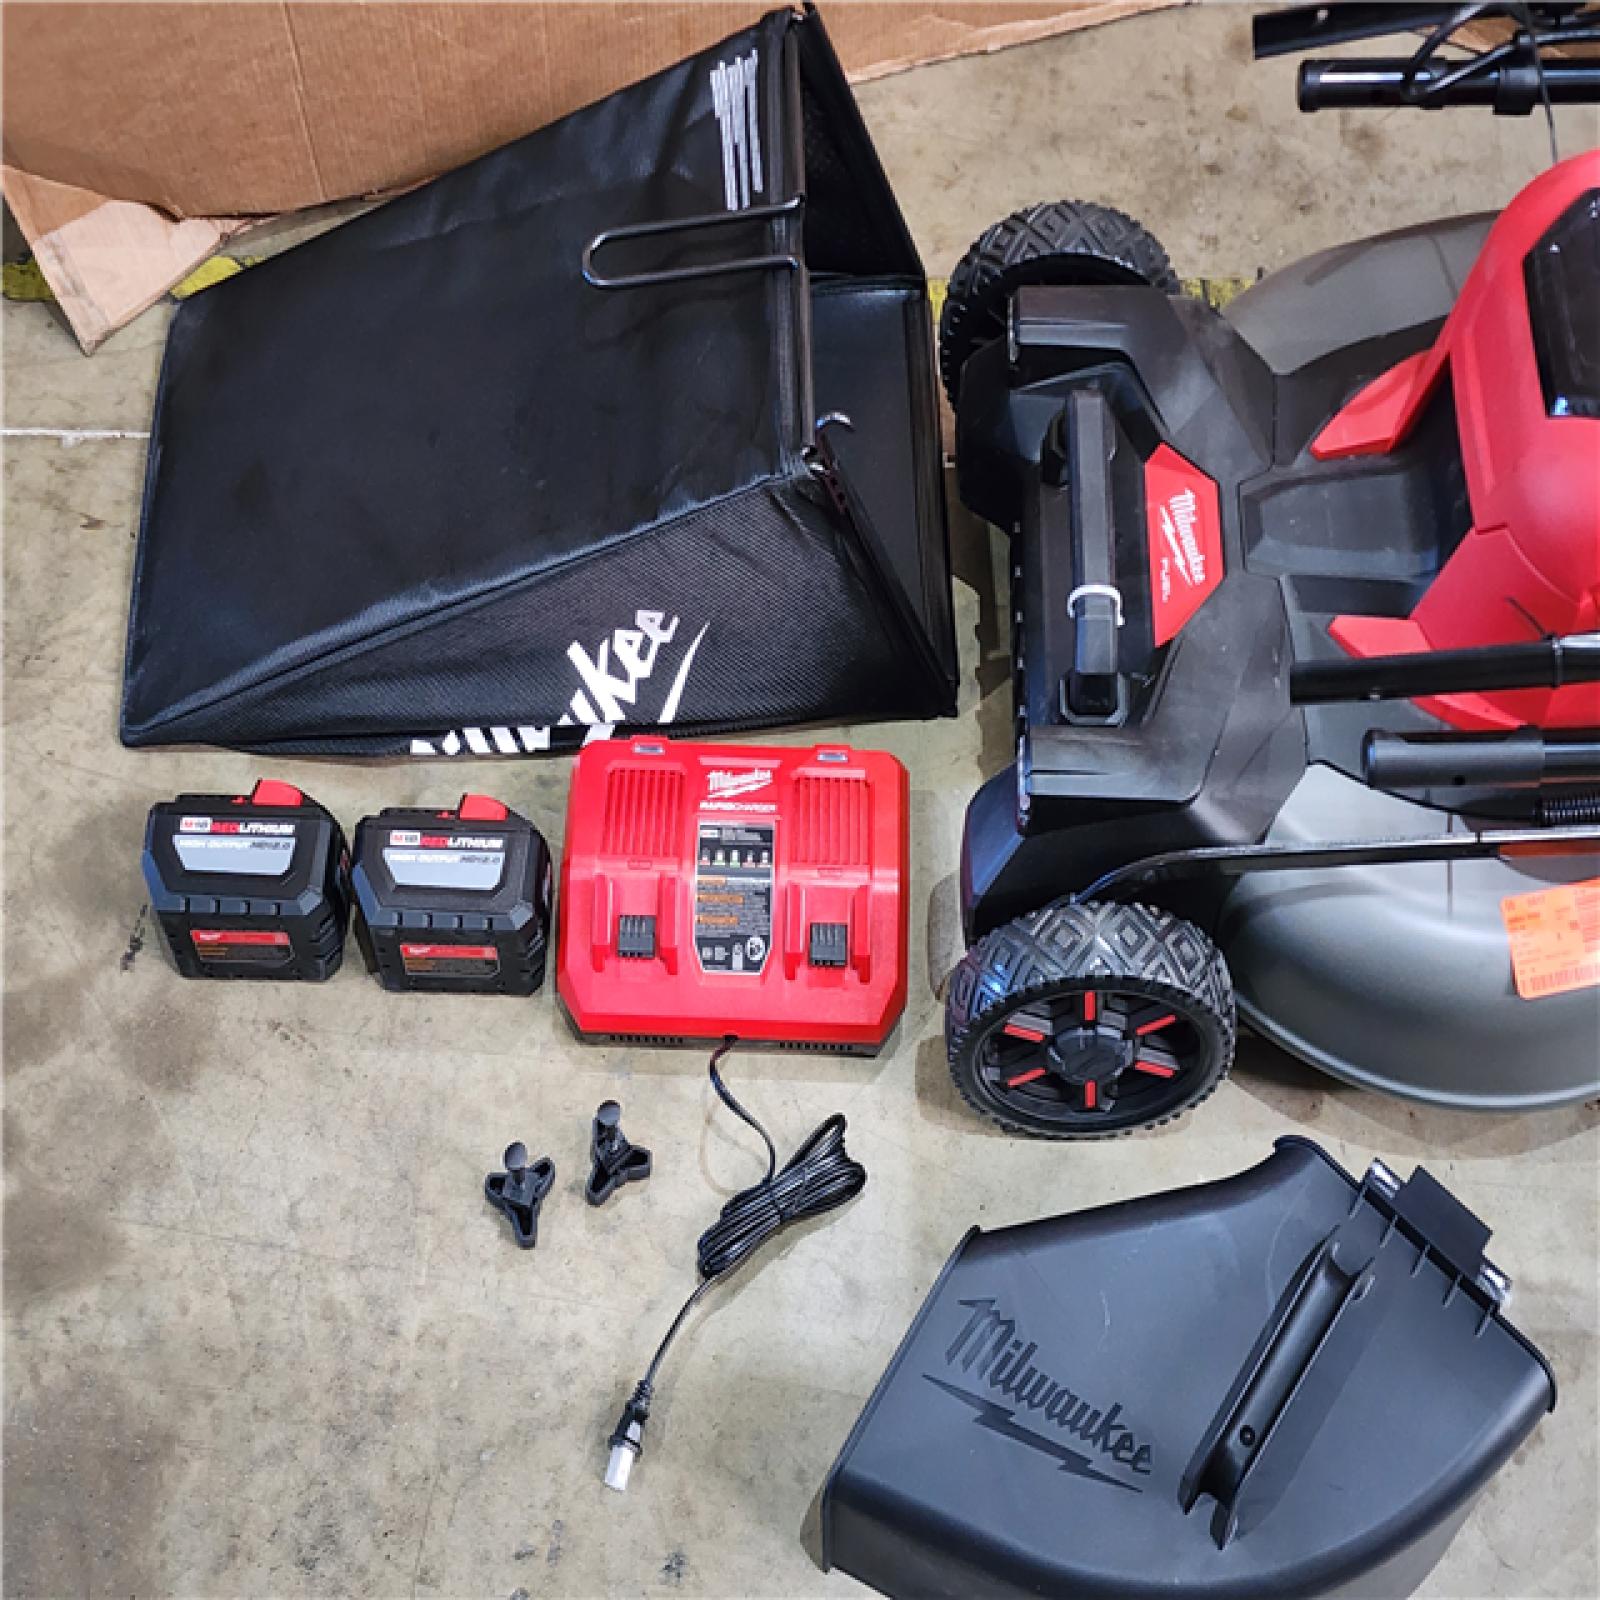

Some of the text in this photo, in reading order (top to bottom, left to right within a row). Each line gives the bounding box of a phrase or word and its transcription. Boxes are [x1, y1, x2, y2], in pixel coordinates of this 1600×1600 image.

[1168, 487, 1206, 586] Milwaukee
[707, 768, 772, 791] Milwaukee
[945, 1298, 1152, 1475] Milwaukee
